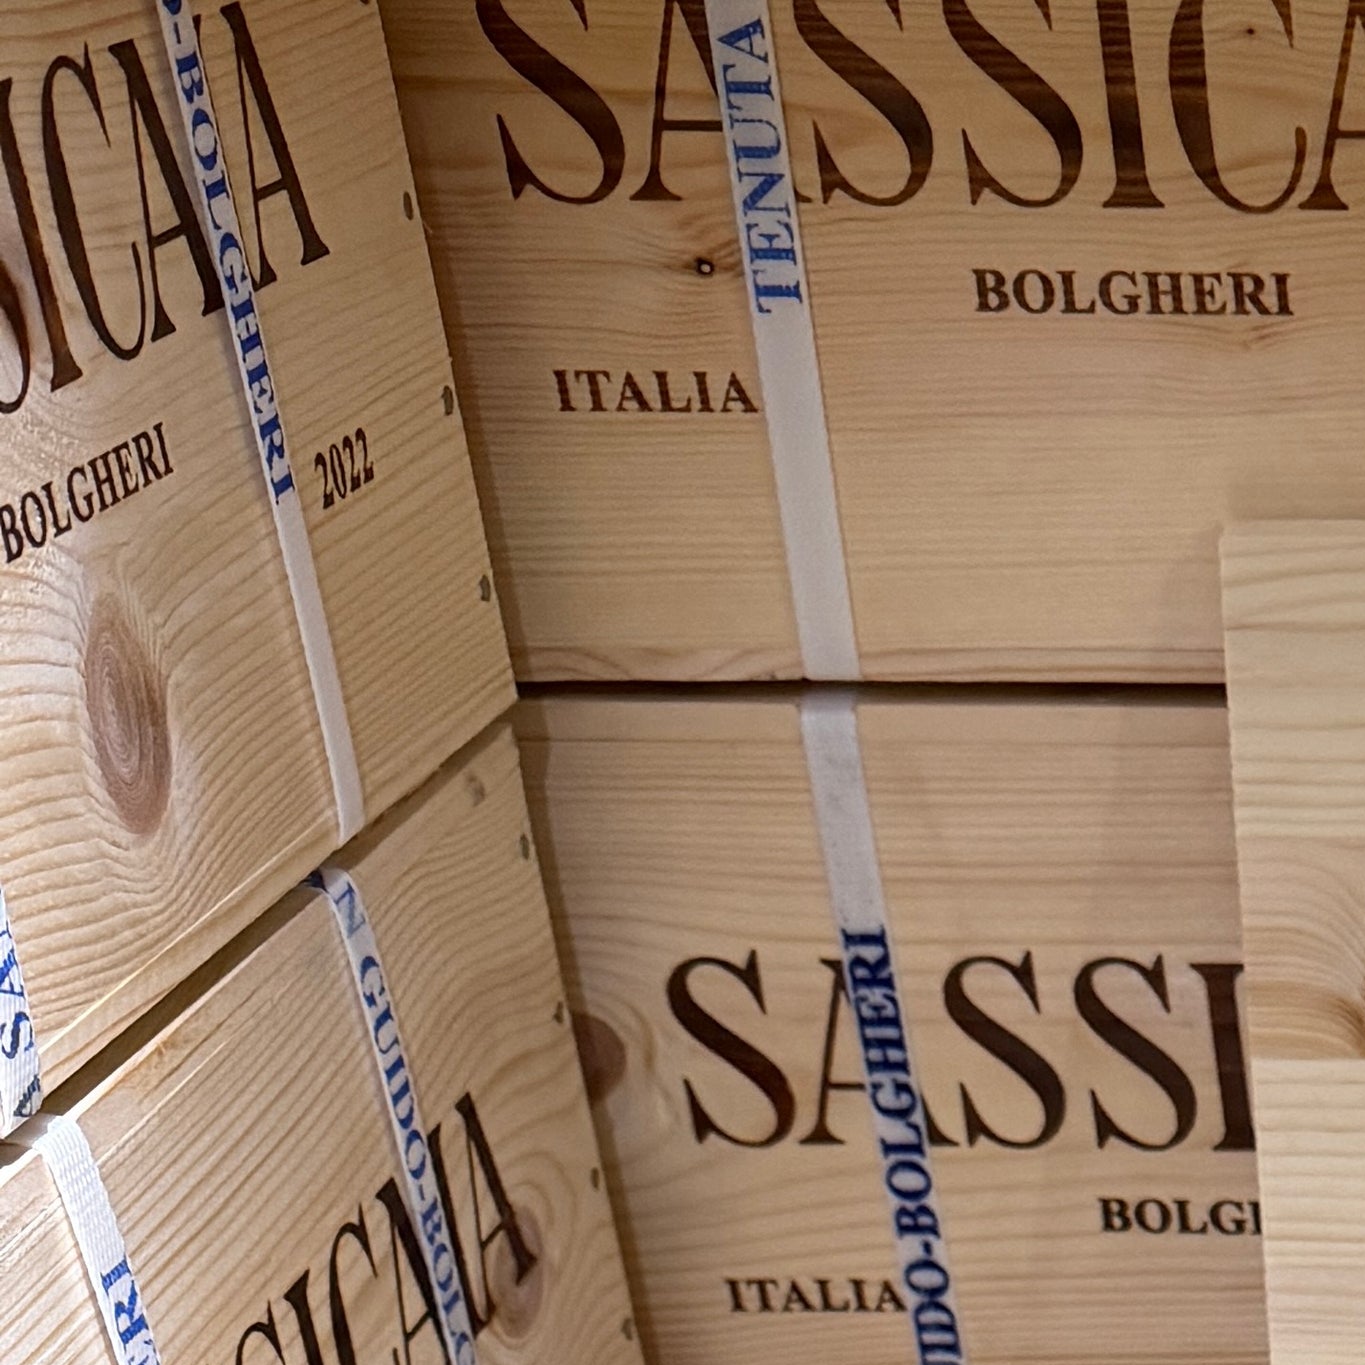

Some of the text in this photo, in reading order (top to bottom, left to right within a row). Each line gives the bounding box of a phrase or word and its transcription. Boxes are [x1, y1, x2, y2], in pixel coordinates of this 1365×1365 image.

[716, 17, 803, 314] TENUTA
[973, 269, 1293, 315] BOLGHERI
[553, 369, 758, 414] ITALIA
[313, 427, 375, 510] 2022
[0, 422, 174, 563] BOLGHERI
[1099, 1198, 1262, 1236] BOLG
[726, 1277, 908, 1313] ITALIA
